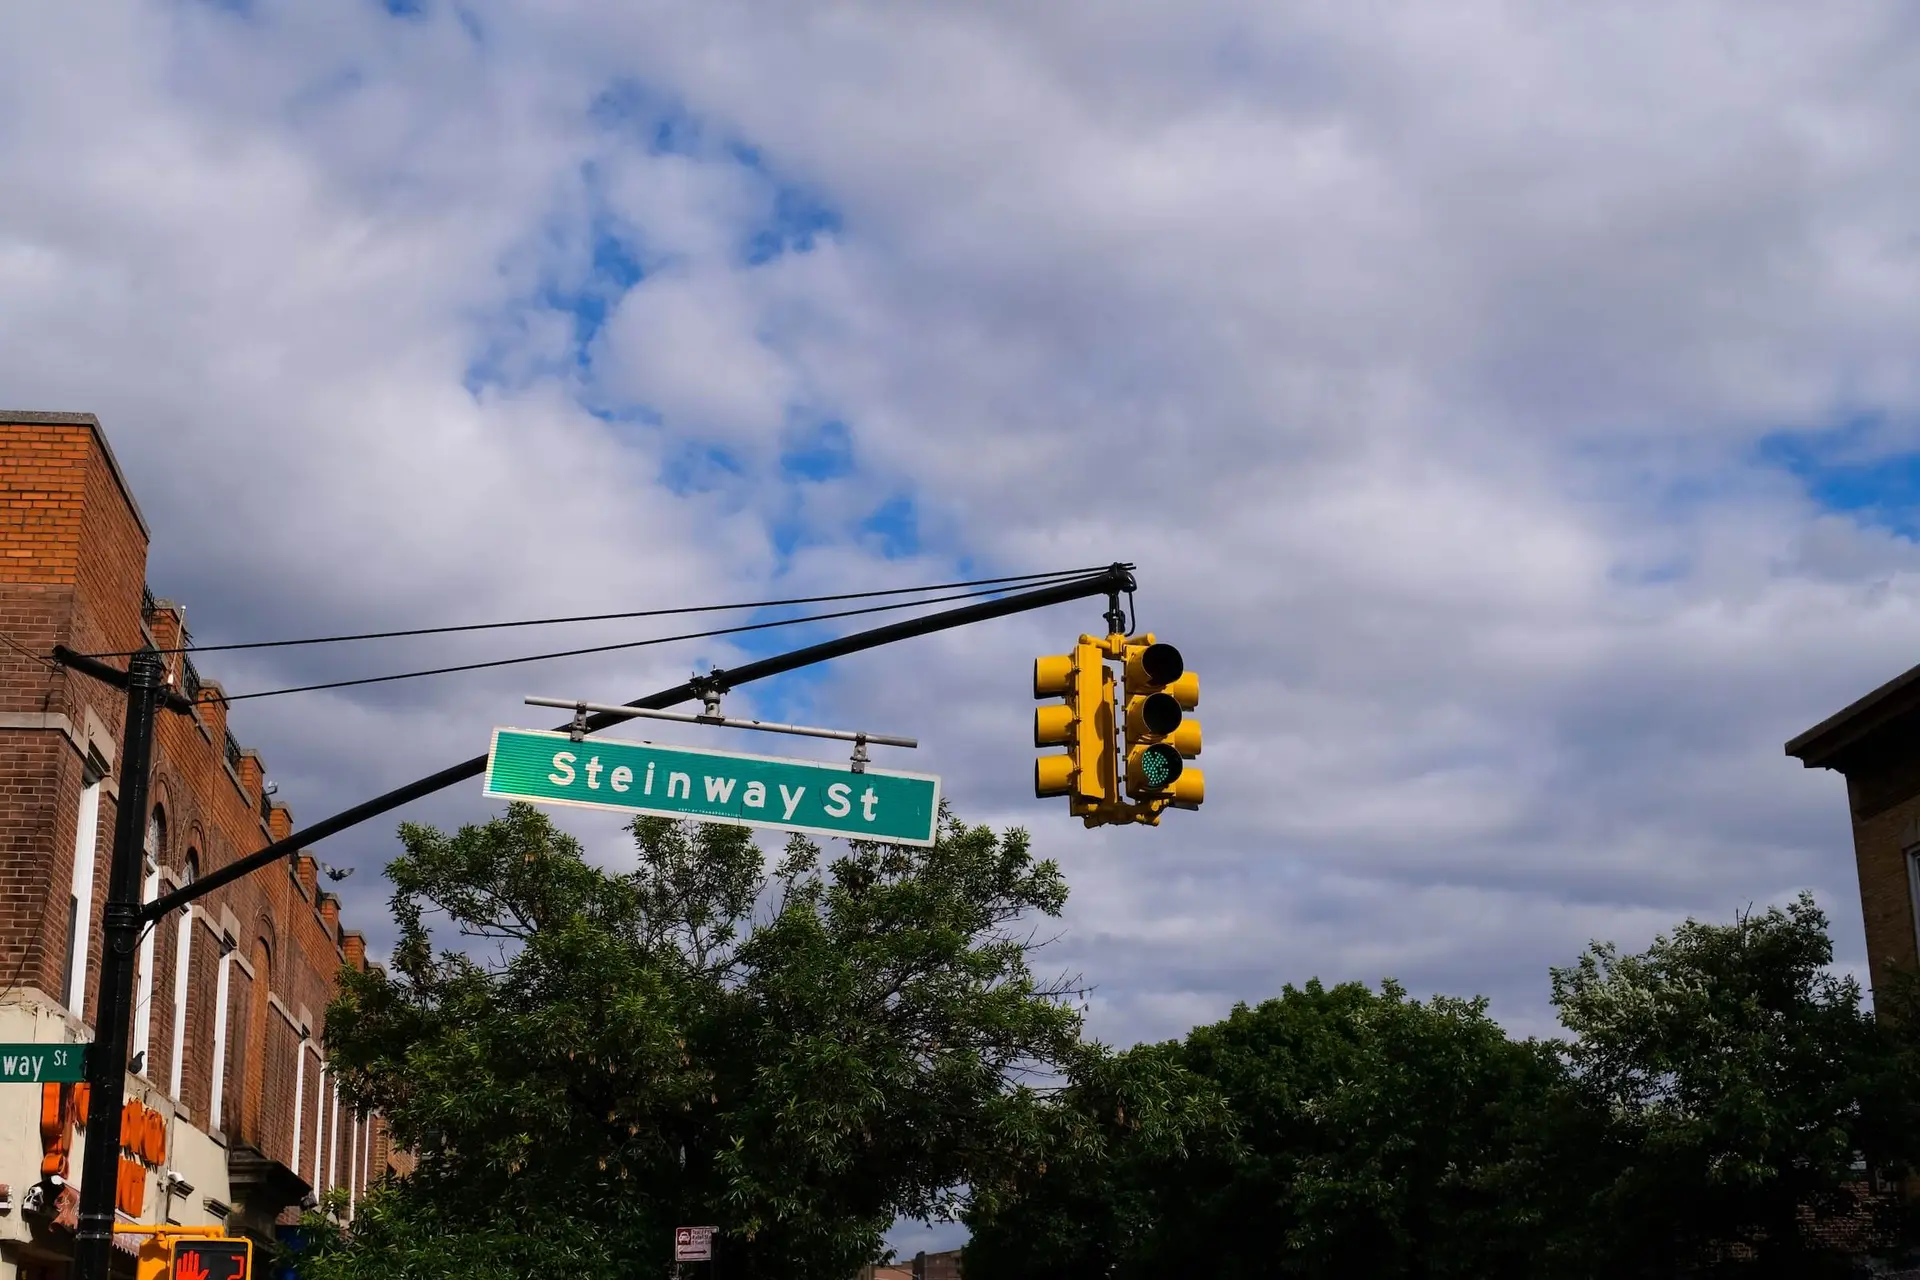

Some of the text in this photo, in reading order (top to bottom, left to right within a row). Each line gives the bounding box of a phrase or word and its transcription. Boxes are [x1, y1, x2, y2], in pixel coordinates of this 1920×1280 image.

[547, 751, 879, 822] Steinway St
[3, 1049, 68, 1082] way St
